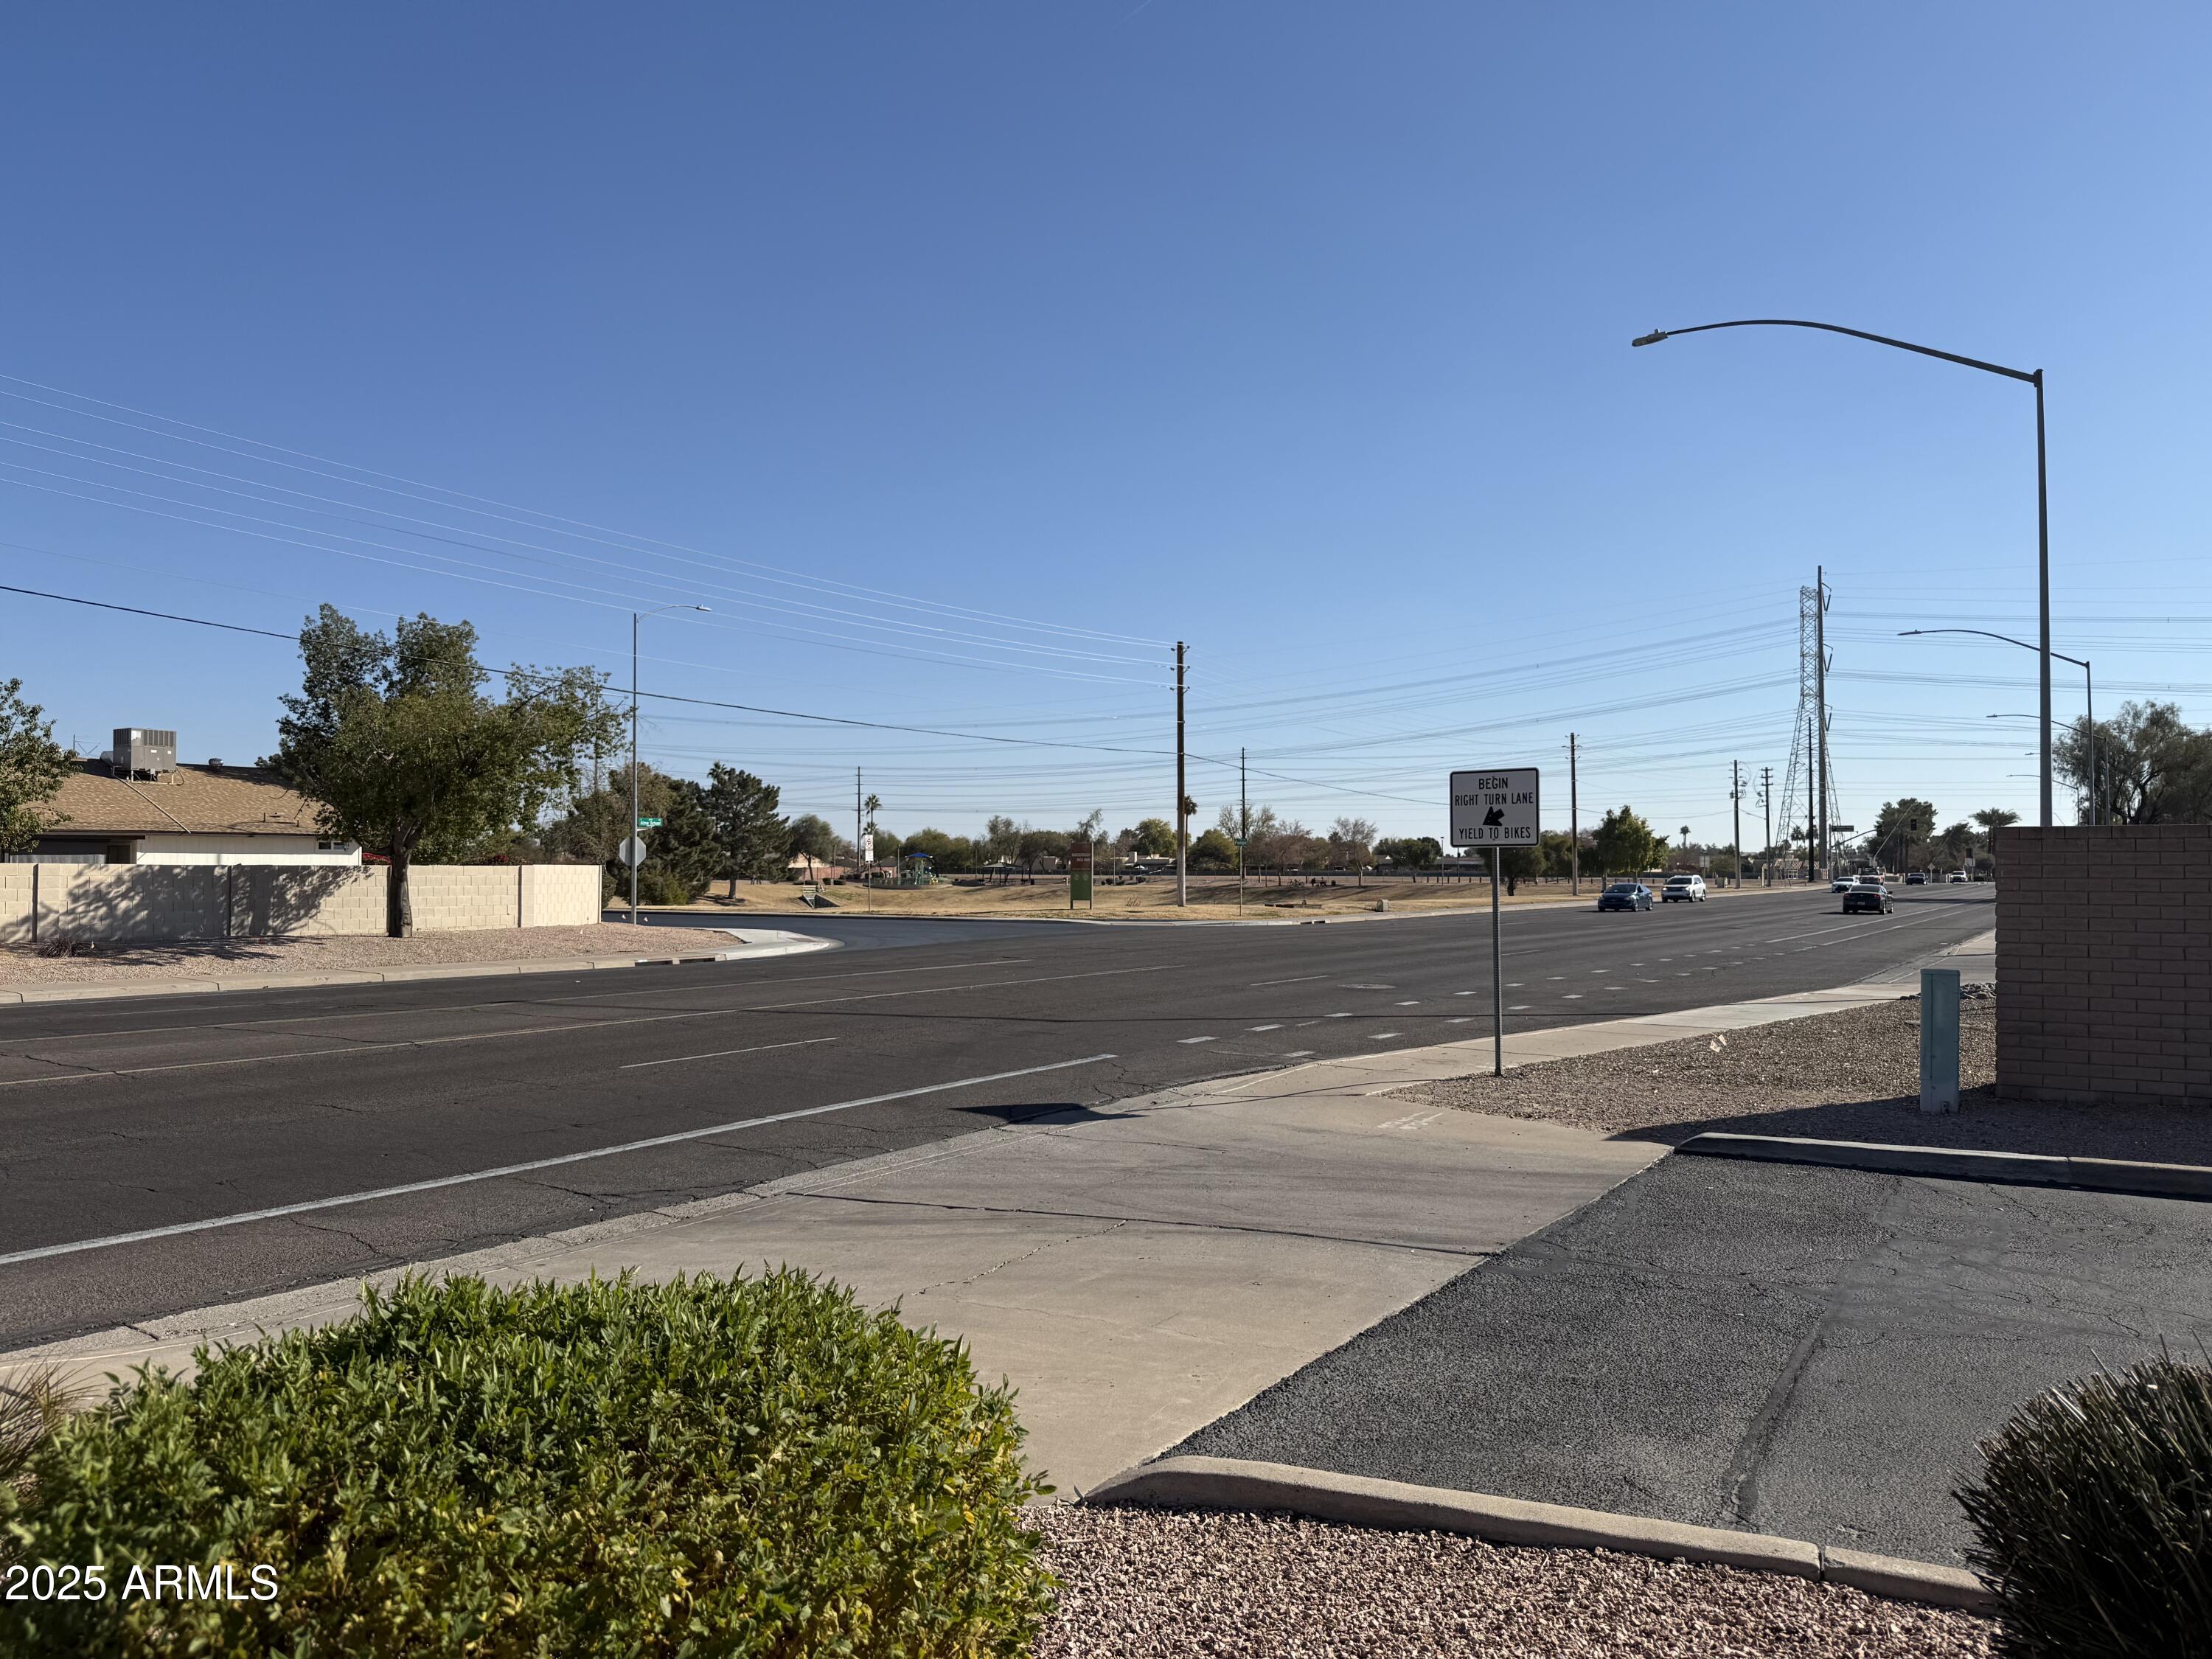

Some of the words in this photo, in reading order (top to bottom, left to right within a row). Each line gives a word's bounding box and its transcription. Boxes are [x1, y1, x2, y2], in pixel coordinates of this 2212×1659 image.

[1478, 777, 1509, 790] BEGIN
[1455, 794, 1479, 806] RIGHT
[1484, 793, 1507, 805] TURN
[1512, 792, 1534, 804] LANE
[1459, 828, 1484, 839] YIELD
[1489, 827, 1499, 839] TO
[1504, 827, 1531, 838] BIKES
